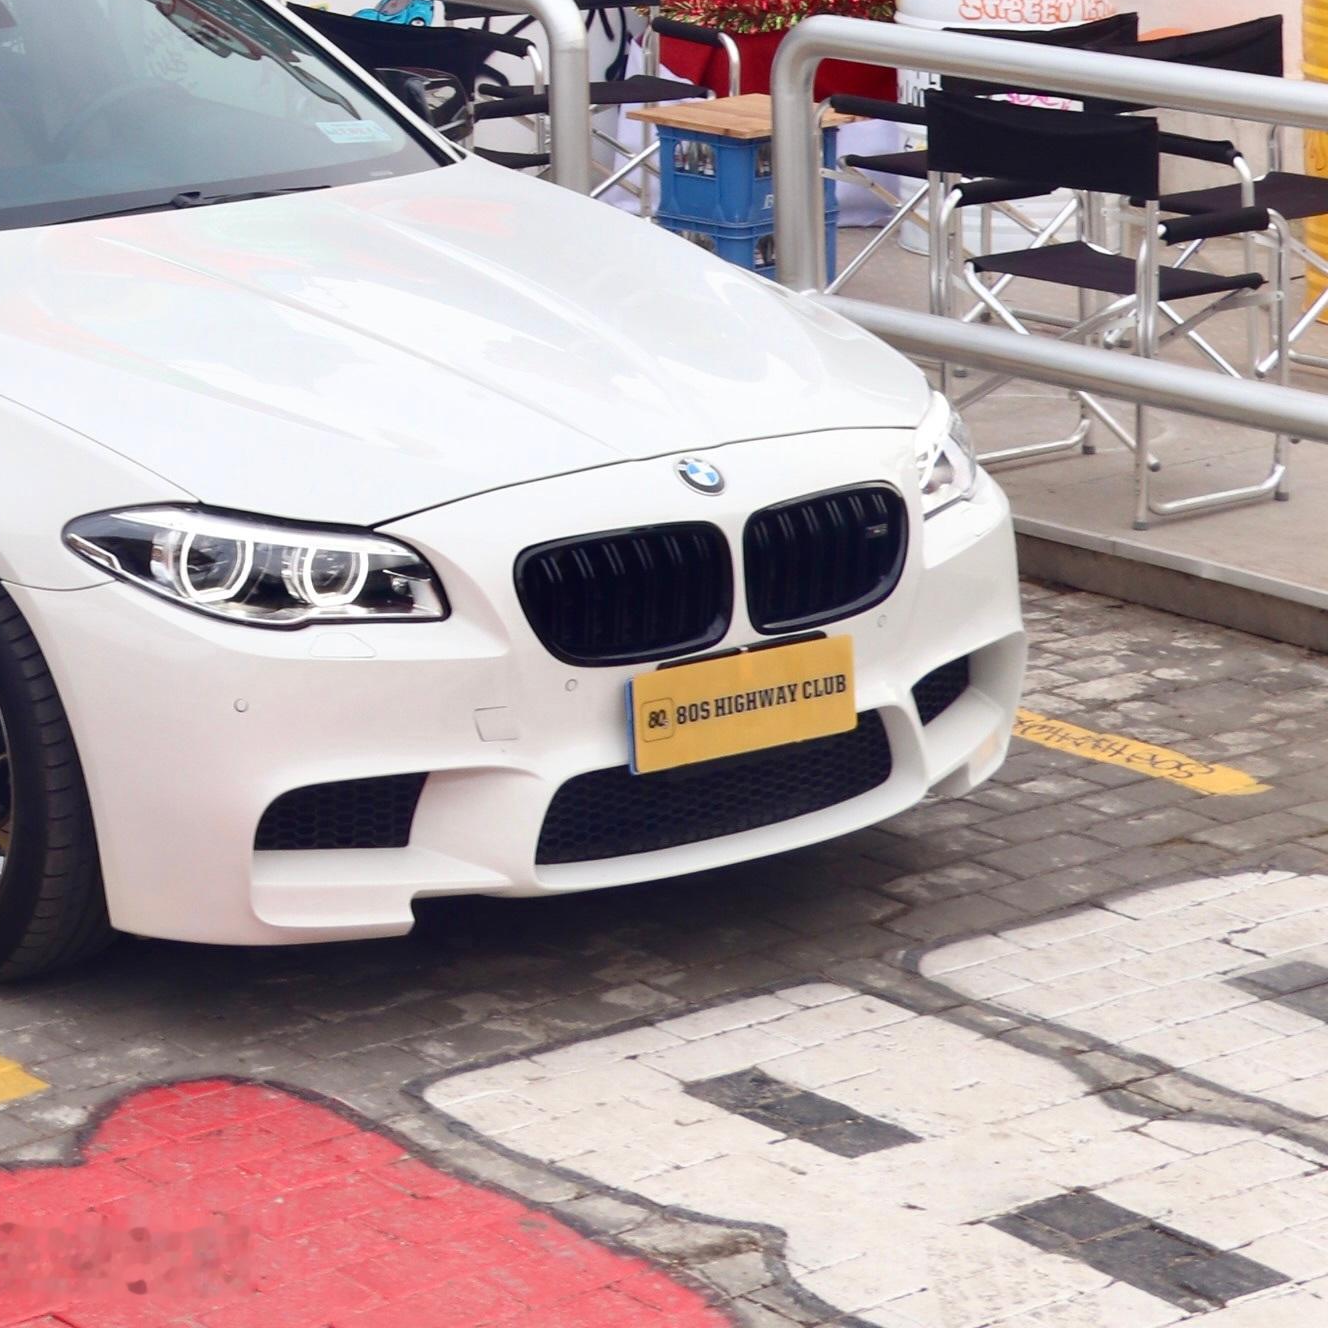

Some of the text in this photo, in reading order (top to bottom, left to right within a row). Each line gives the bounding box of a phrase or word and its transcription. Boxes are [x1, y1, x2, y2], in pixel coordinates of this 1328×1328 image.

[676, 700, 710, 725] 80S
[714, 683, 798, 718] HIGHWAY
[802, 674, 847, 701] CLUB
